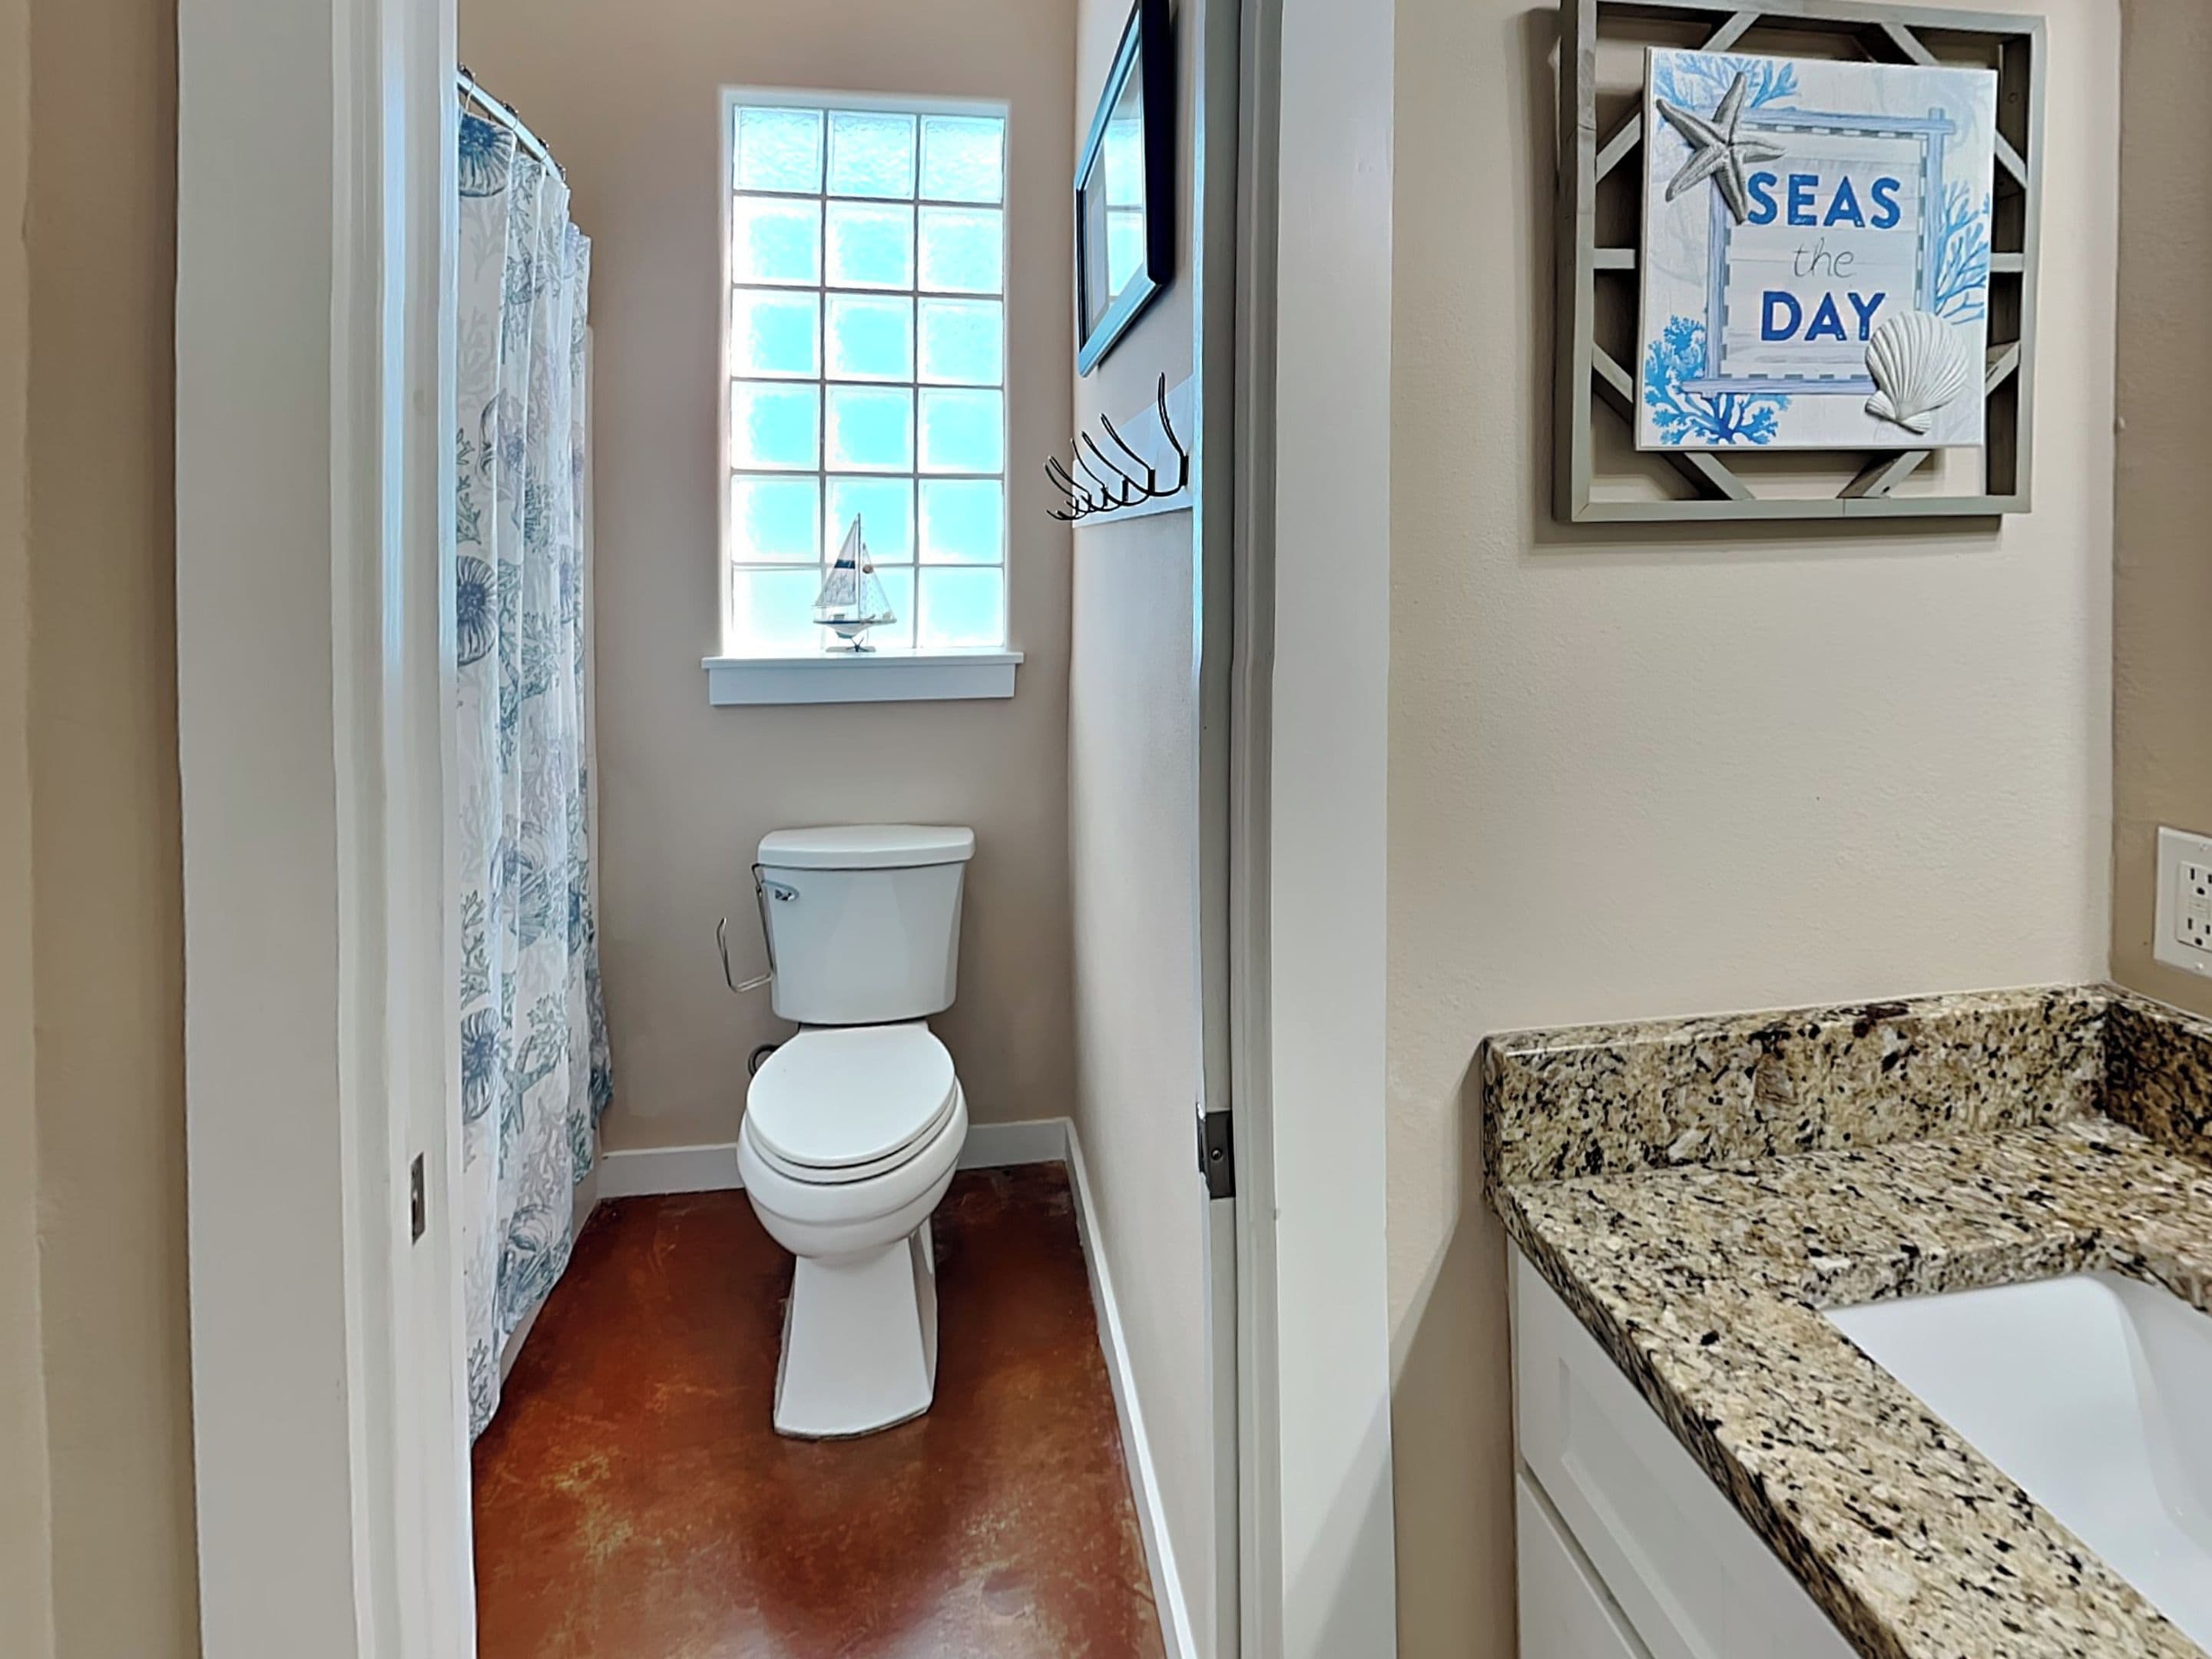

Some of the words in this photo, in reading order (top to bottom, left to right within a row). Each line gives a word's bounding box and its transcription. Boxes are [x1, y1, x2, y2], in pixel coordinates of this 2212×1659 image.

[1747, 172, 1901, 229] SEAS
[1793, 237, 1855, 278] the
[1761, 291, 1886, 341] DAY
